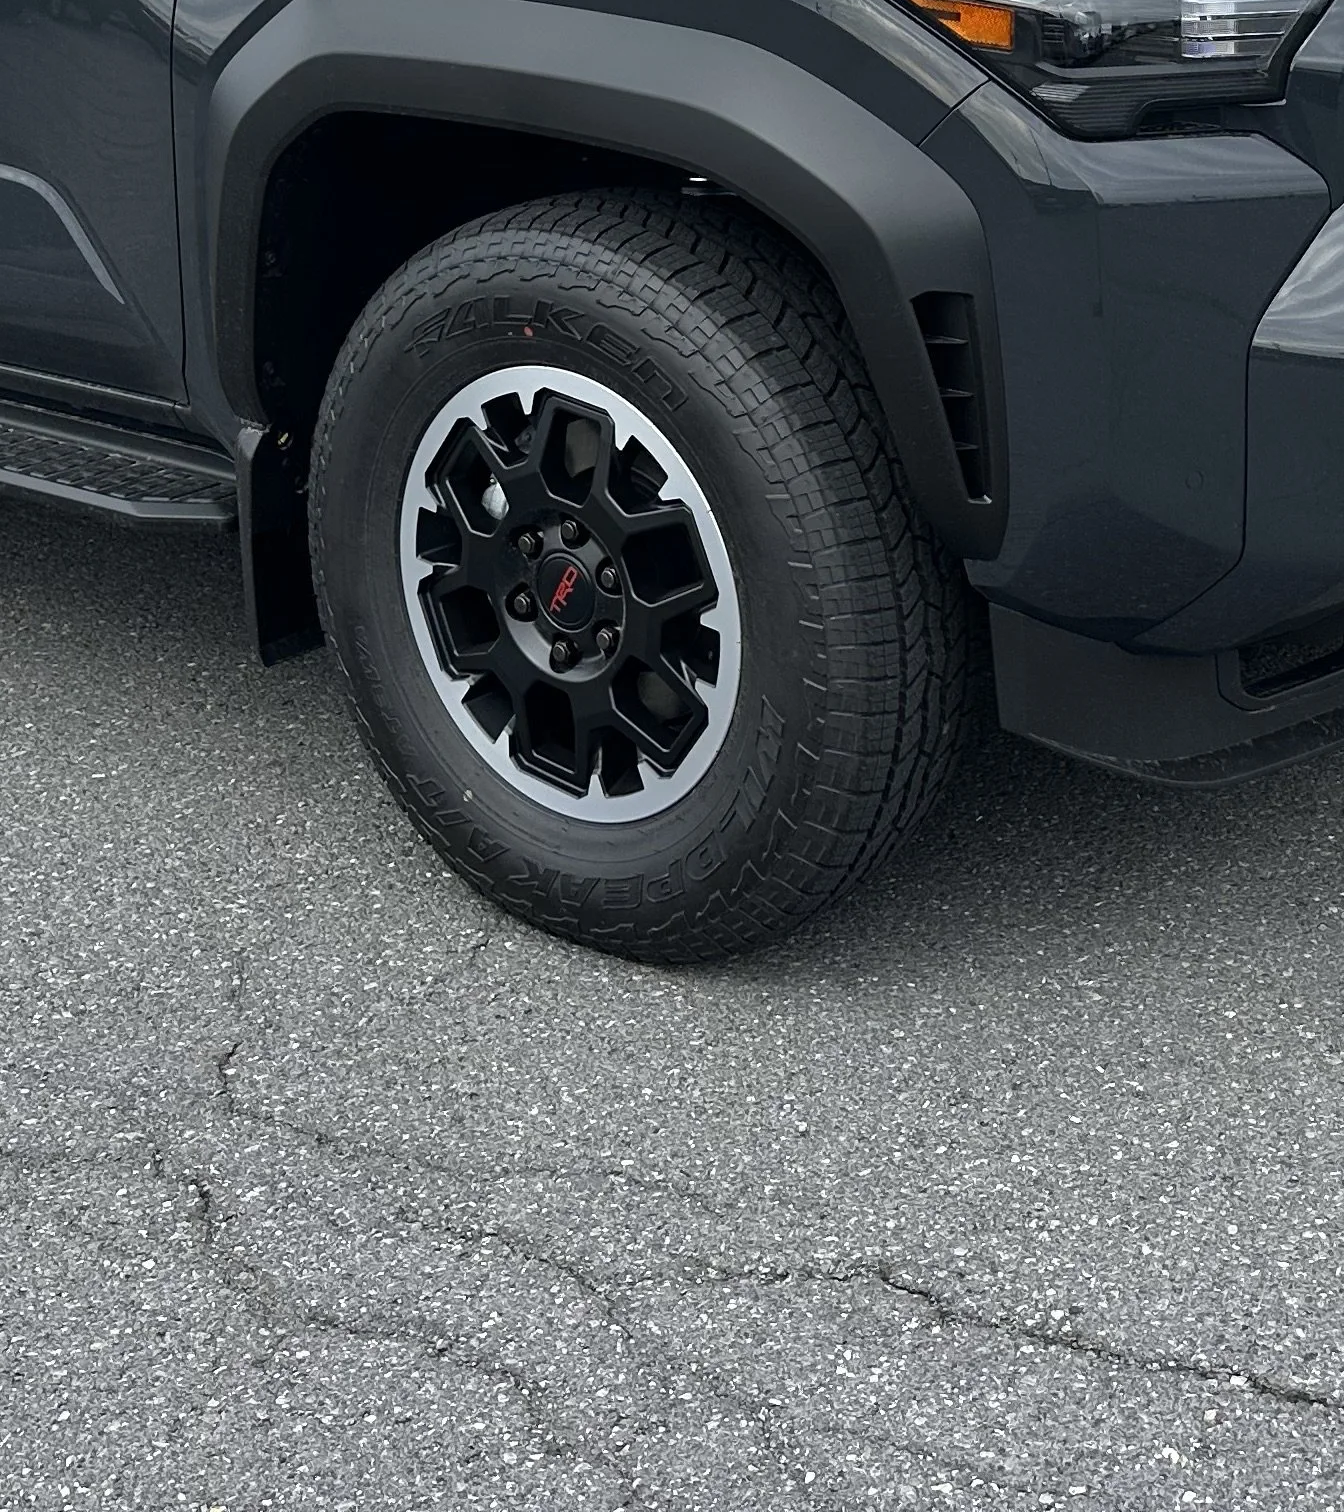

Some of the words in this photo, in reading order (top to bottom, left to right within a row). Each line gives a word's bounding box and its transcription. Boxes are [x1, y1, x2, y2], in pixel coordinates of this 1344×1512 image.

[404, 294, 689, 414] FALKEN
[549, 565, 579, 613] TRD
[505, 693, 787, 910] WILDPEAK
